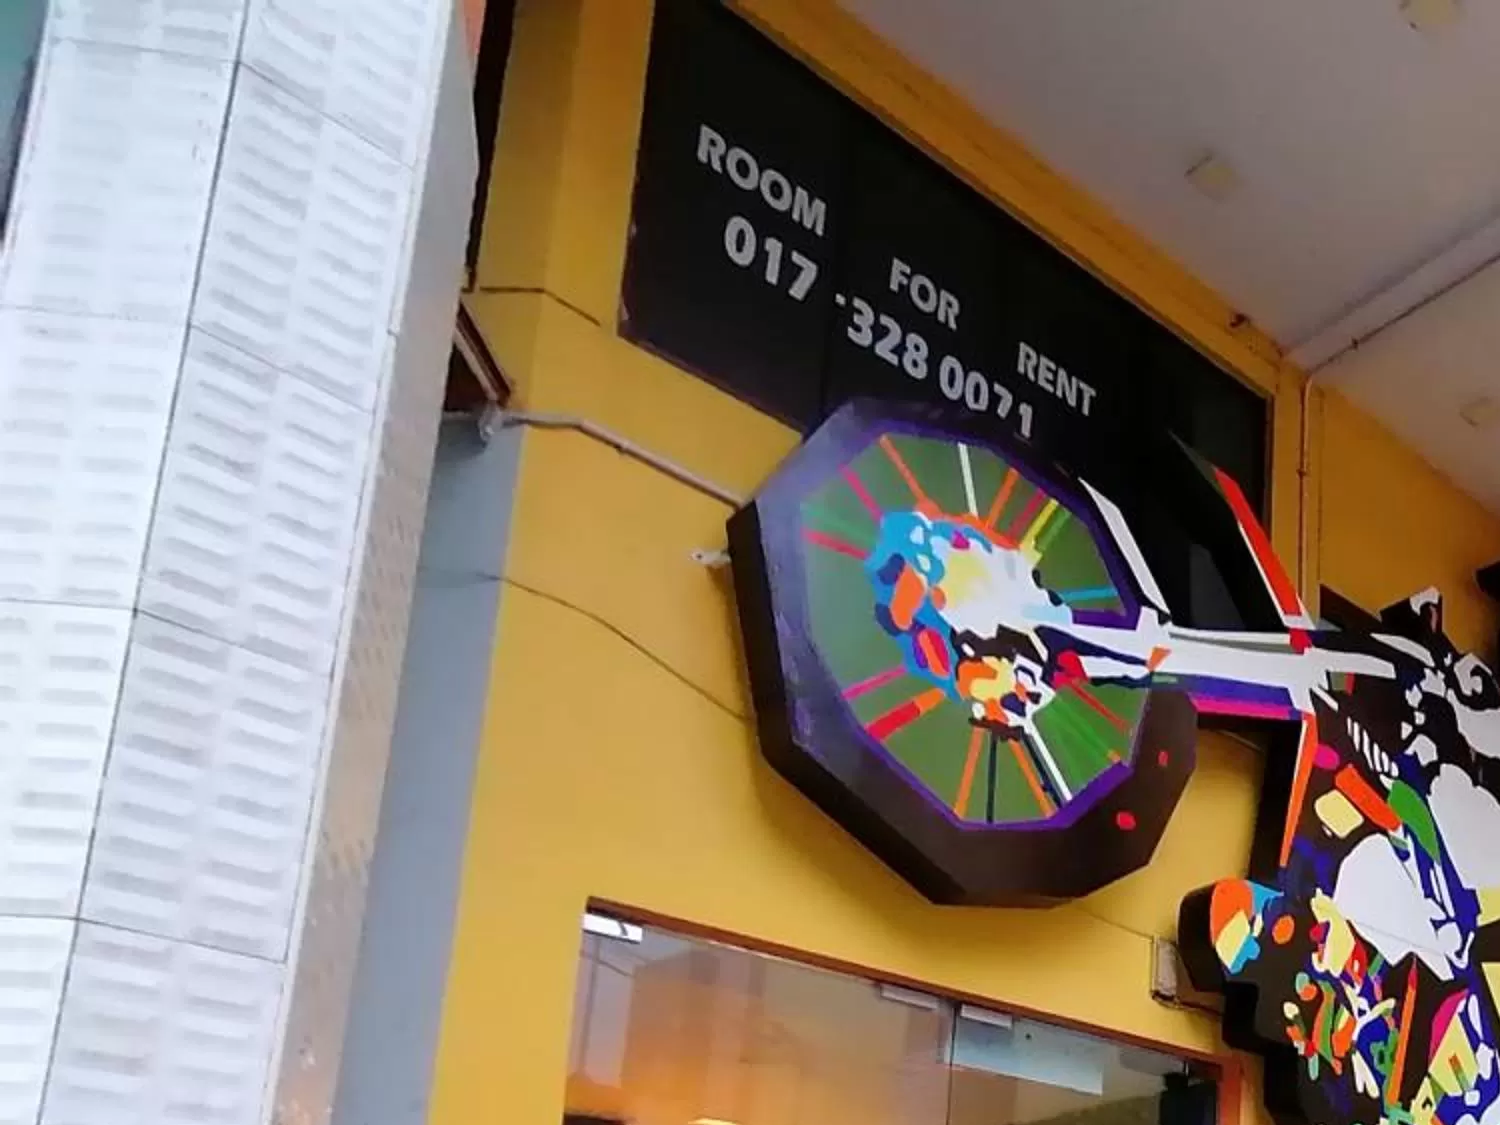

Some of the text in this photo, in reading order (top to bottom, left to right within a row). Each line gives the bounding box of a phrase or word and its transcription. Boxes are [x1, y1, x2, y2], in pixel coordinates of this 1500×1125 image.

[697, 124, 1097, 416] ROOM FOR RENT
[723, 216, 818, 302] 017
[939, 355, 1033, 438] 0071
